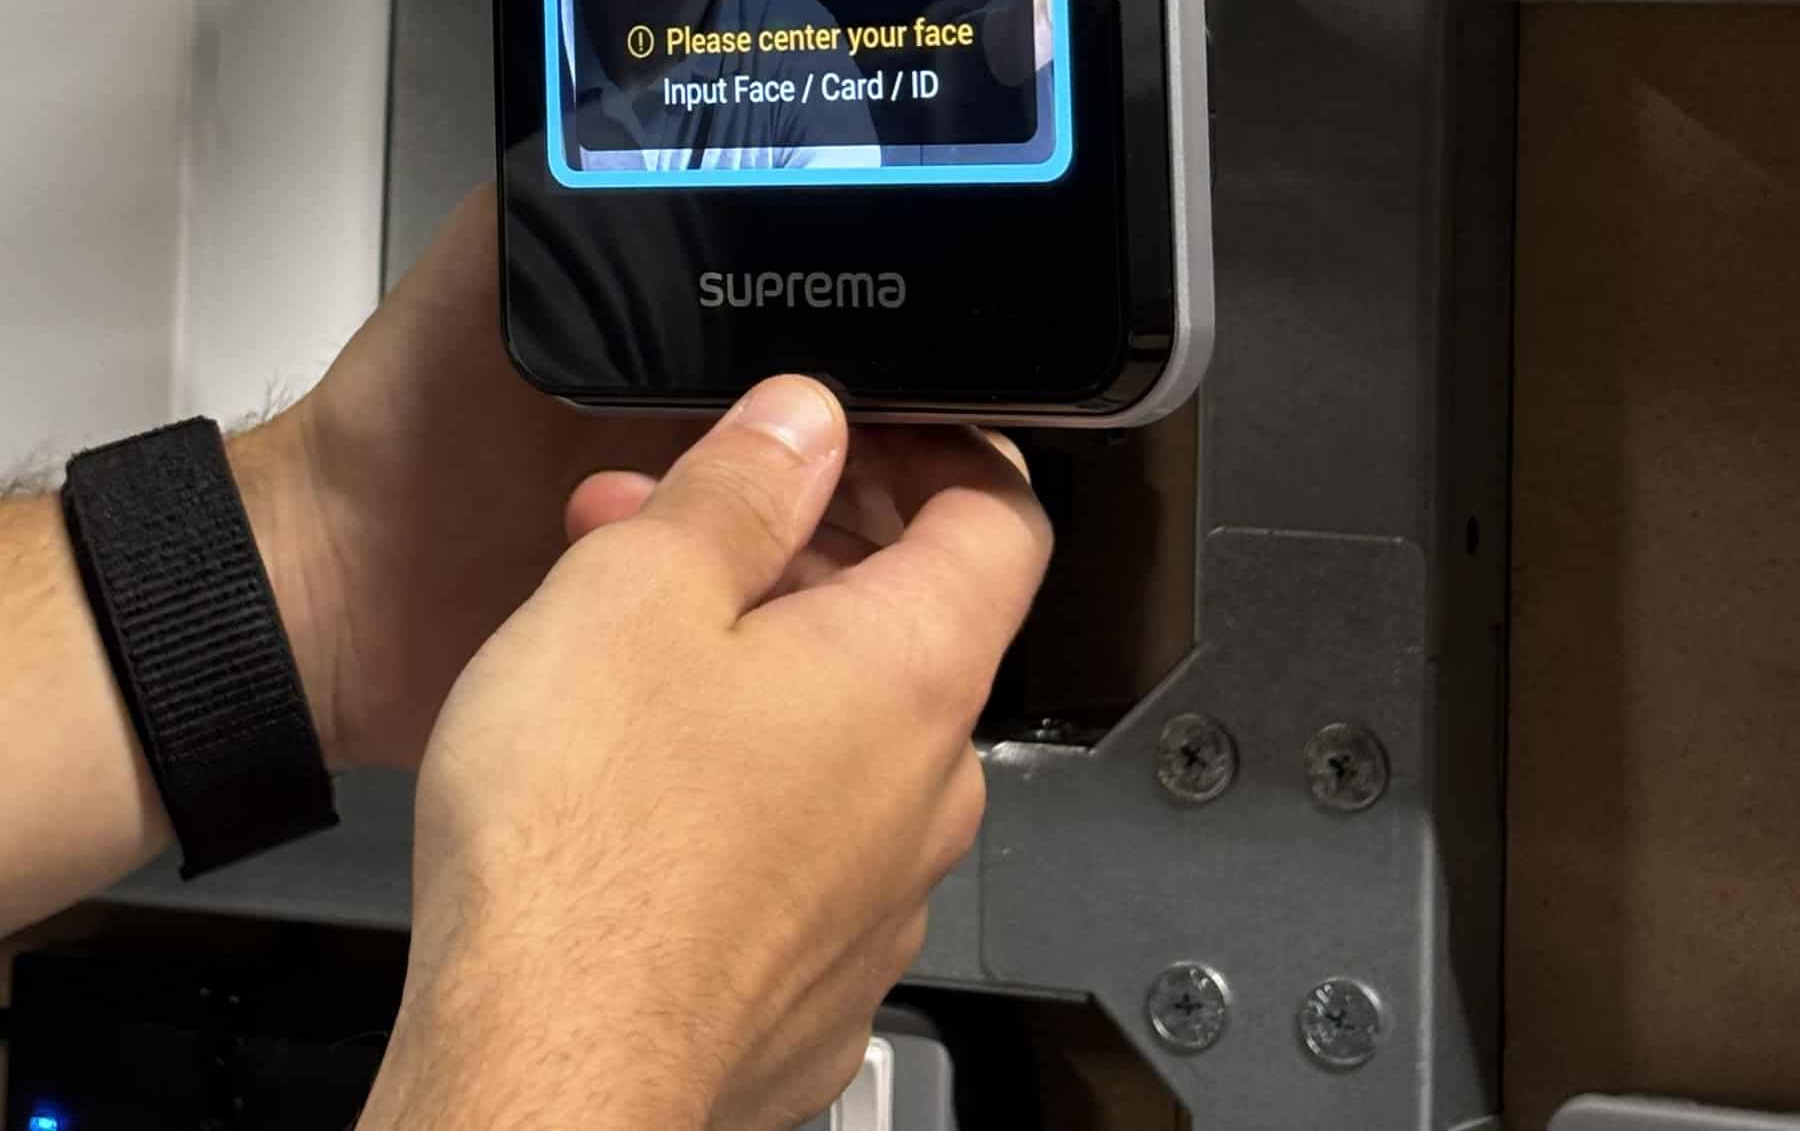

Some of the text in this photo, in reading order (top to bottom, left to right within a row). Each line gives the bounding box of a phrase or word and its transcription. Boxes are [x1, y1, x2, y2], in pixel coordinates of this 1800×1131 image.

[666, 17, 974, 57] Please center your face
[663, 70, 939, 111] Input Face / Card / ID
[699, 271, 906, 309] suprema
